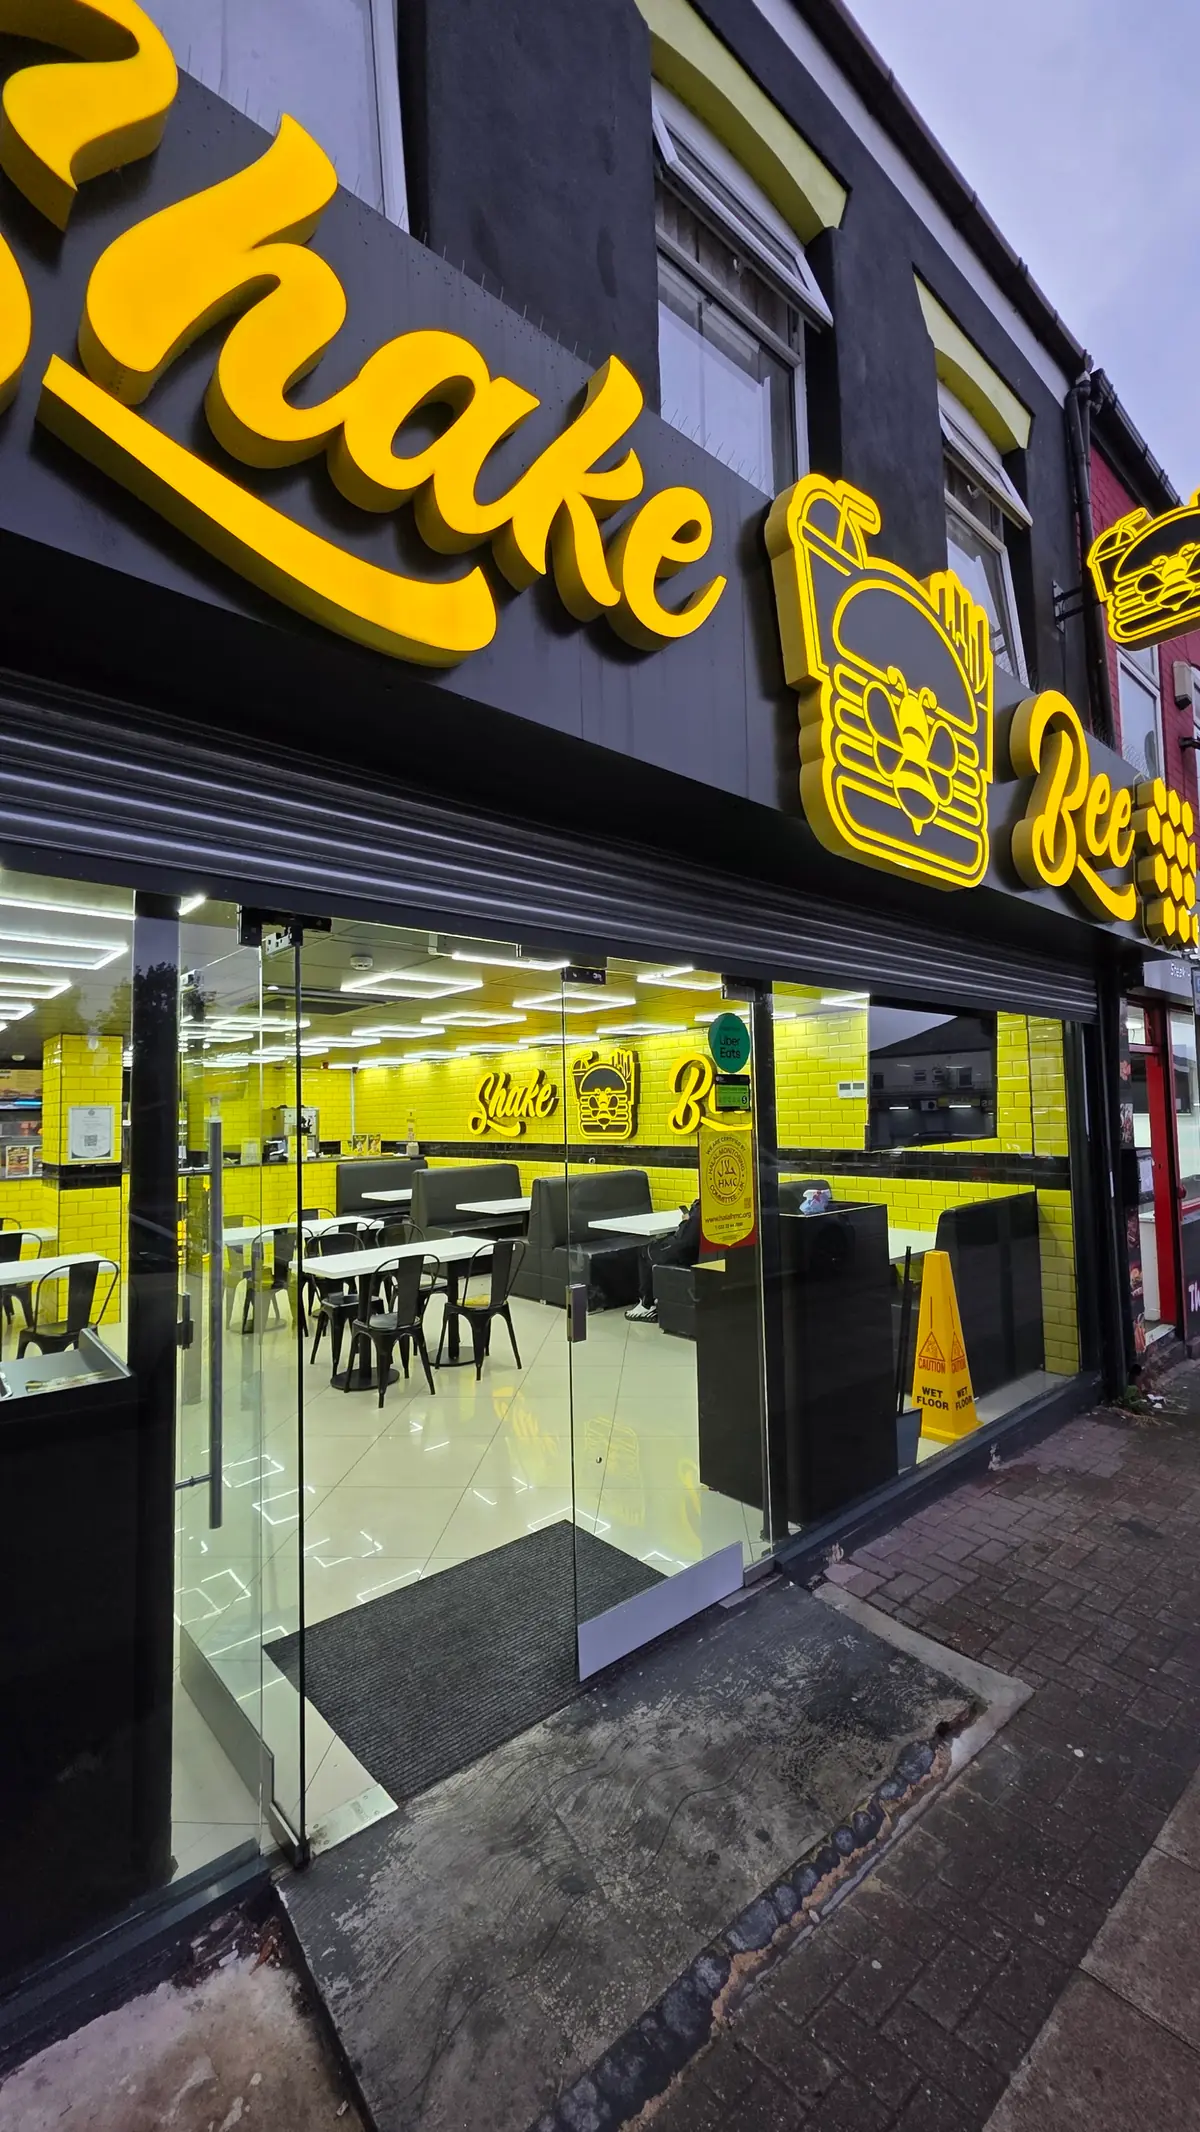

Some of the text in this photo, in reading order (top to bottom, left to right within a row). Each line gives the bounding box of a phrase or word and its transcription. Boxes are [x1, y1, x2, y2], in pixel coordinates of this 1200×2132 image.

[1020, 690, 1136, 920] Bee
[719, 1034, 741, 1046] Uber
[719, 1046, 741, 1059] Eats
[468, 1069, 558, 1137] Shake
[718, 1177, 738, 1188] HMC
[918, 1357, 946, 1374] CAUTION
[921, 1386, 943, 1398] WET
[956, 1386, 968, 1398] WET
[916, 1395, 949, 1411] FLOOR
